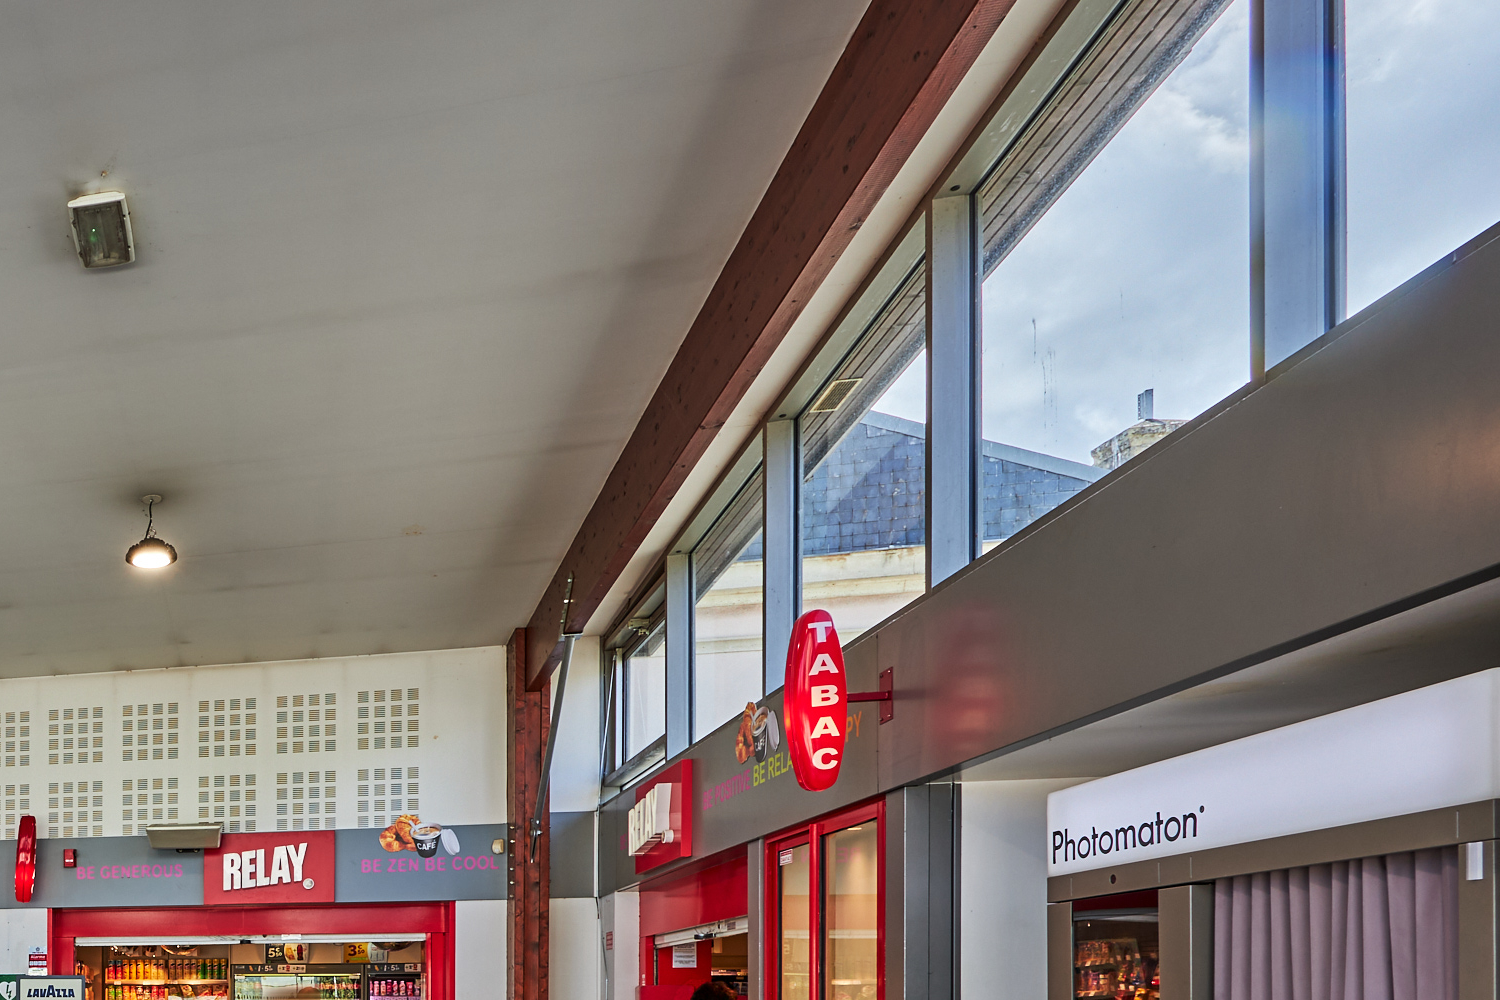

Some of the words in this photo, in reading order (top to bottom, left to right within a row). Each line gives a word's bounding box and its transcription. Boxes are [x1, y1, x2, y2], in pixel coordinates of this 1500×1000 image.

[808, 621, 840, 770] TABAC
[702, 788, 713, 811] BE
[714, 768, 751, 805] POSITIVE
[753, 761, 766, 787] BE
[768, 751, 794, 780] RELA
[628, 783, 661, 856] RELAY
[1052, 811, 1198, 865] Photomaton
[222, 843, 308, 891] RELAY
[361, 858, 382, 873] BE
[387, 858, 419, 873] ZEN
[425, 857, 446, 871] BE
[452, 855, 499, 871] COOL
[416, 839, 437, 851] CAFÉ
[76, 866, 95, 880] BE
[100, 864, 184, 879] GENEROUS
[27, 985, 75, 997] LAVAZZA
